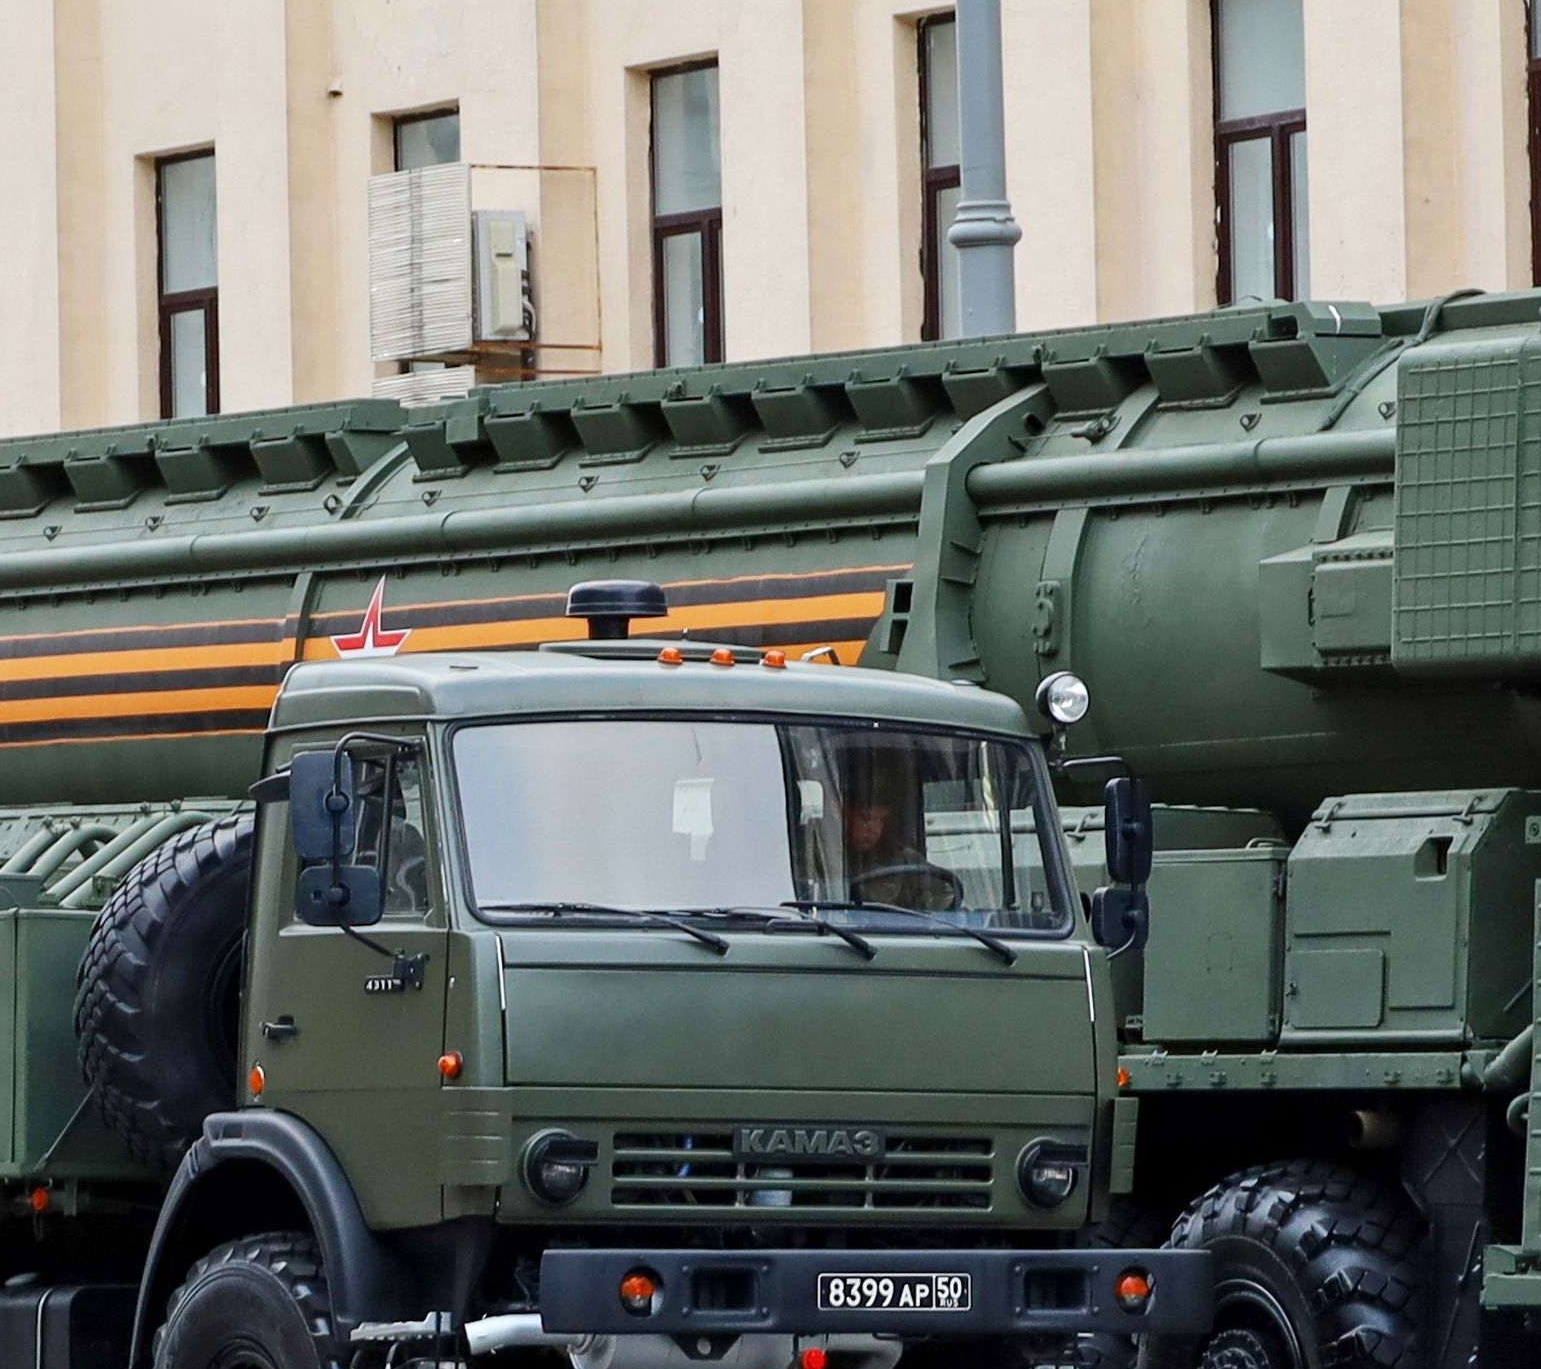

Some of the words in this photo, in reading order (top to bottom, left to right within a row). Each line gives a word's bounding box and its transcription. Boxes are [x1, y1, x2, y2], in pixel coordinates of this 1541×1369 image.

[741, 1128, 879, 1156] КАМАЗ
[829, 1278, 894, 1307] 8399
[899, 1284, 930, 1307] АР
[937, 1276, 962, 1299] 50
[939, 1297, 959, 1308] RUS
